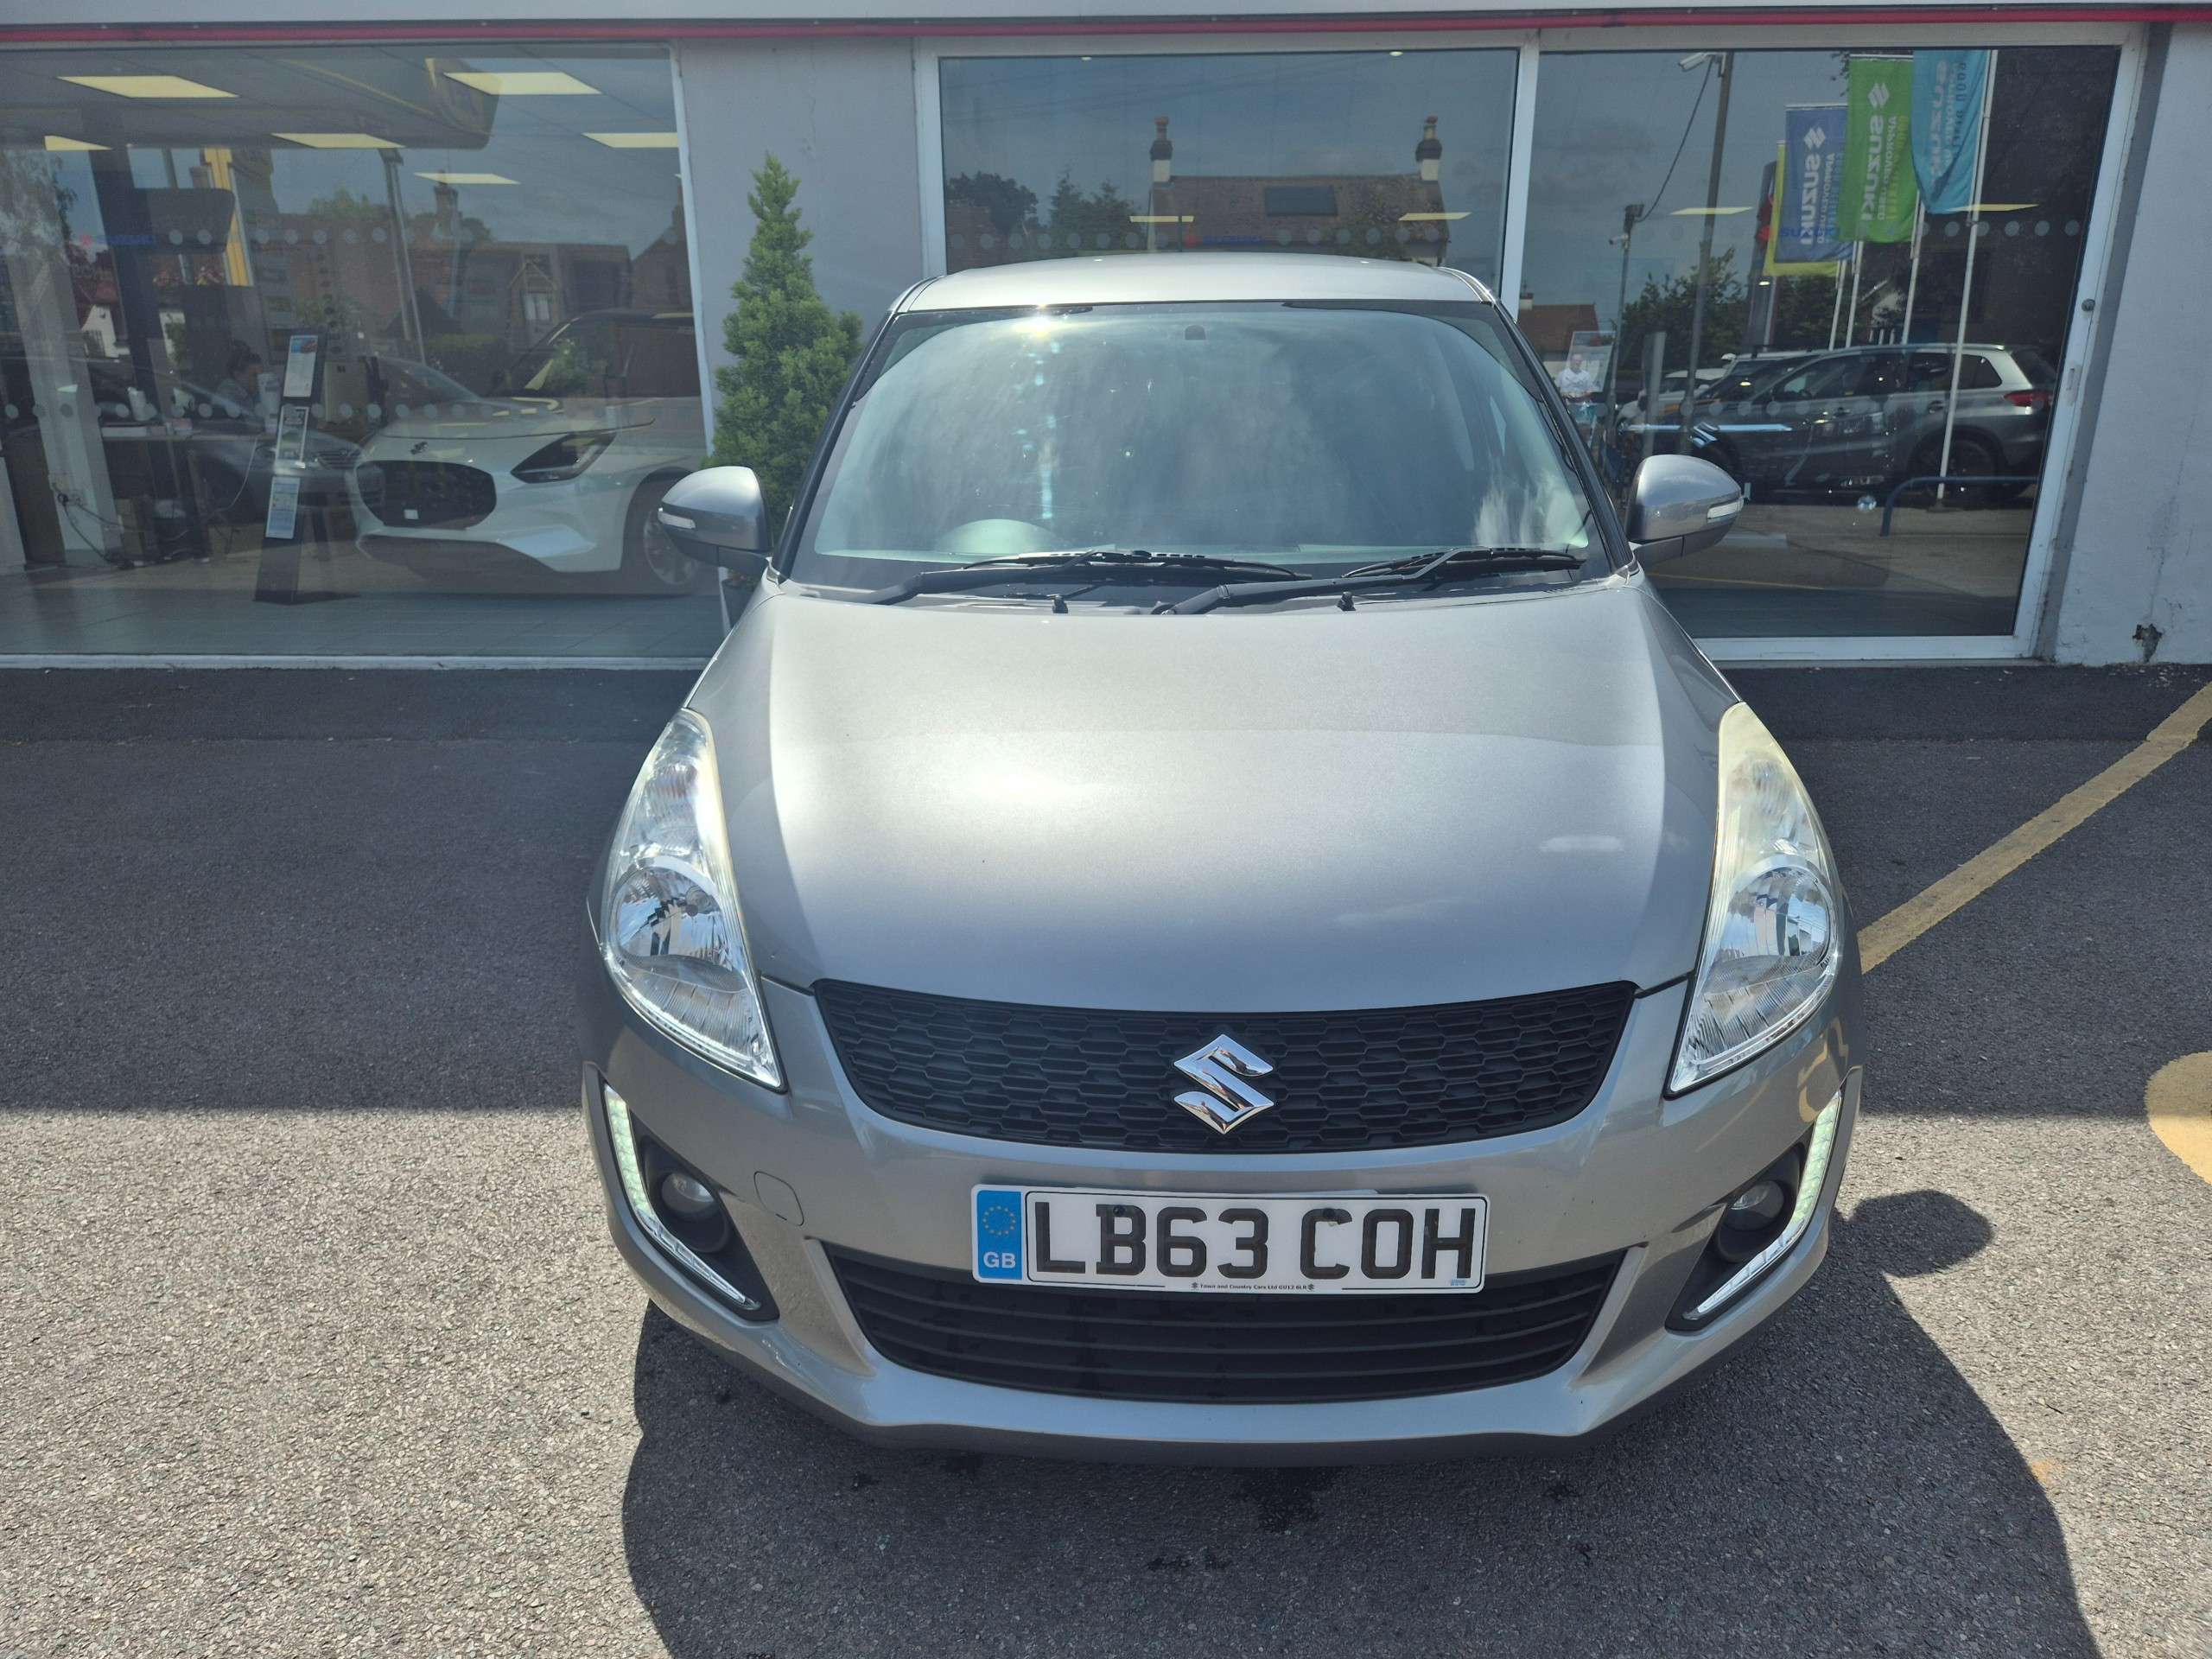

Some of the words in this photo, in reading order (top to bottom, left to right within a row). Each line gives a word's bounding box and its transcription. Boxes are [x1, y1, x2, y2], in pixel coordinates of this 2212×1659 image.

[983, 1251, 1016, 1269] GB
[1034, 1201, 1269, 1279] LB63
[1300, 1207, 1476, 1280] COH
